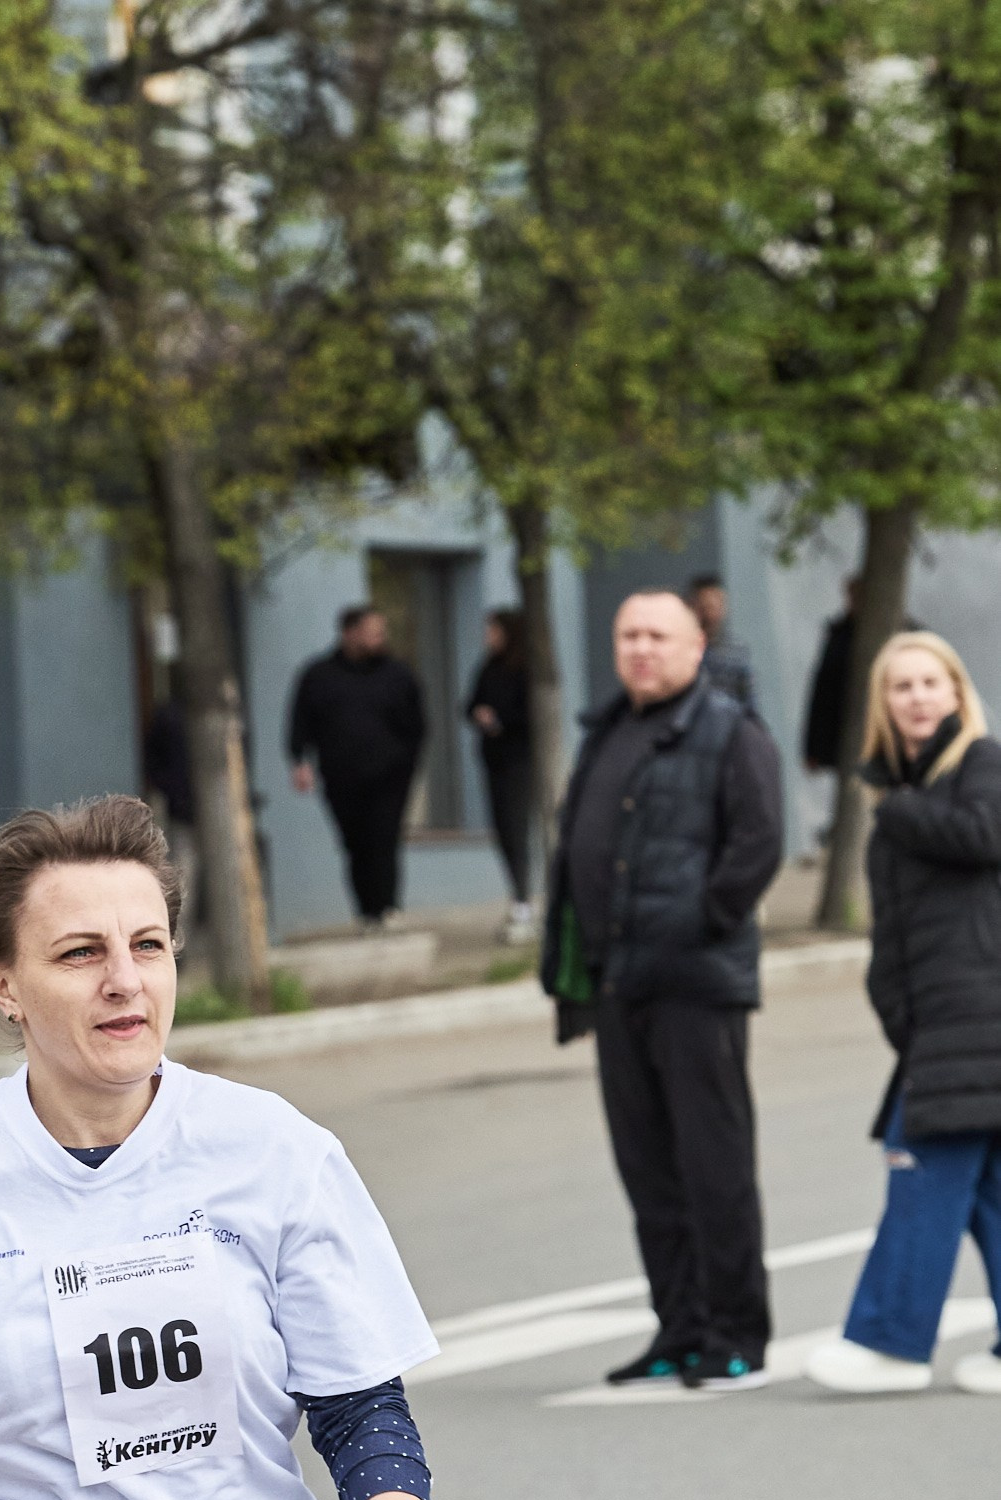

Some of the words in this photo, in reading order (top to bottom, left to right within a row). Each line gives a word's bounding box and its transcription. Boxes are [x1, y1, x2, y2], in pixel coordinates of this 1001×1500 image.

[54, 1264, 80, 1296] 90
[83, 1319, 202, 1396] 106
[115, 1429, 217, 1463] Кенгуру
[138, 1433, 158, 1443] ДОМ
[161, 1425, 196, 1438] РЕМОНТ
